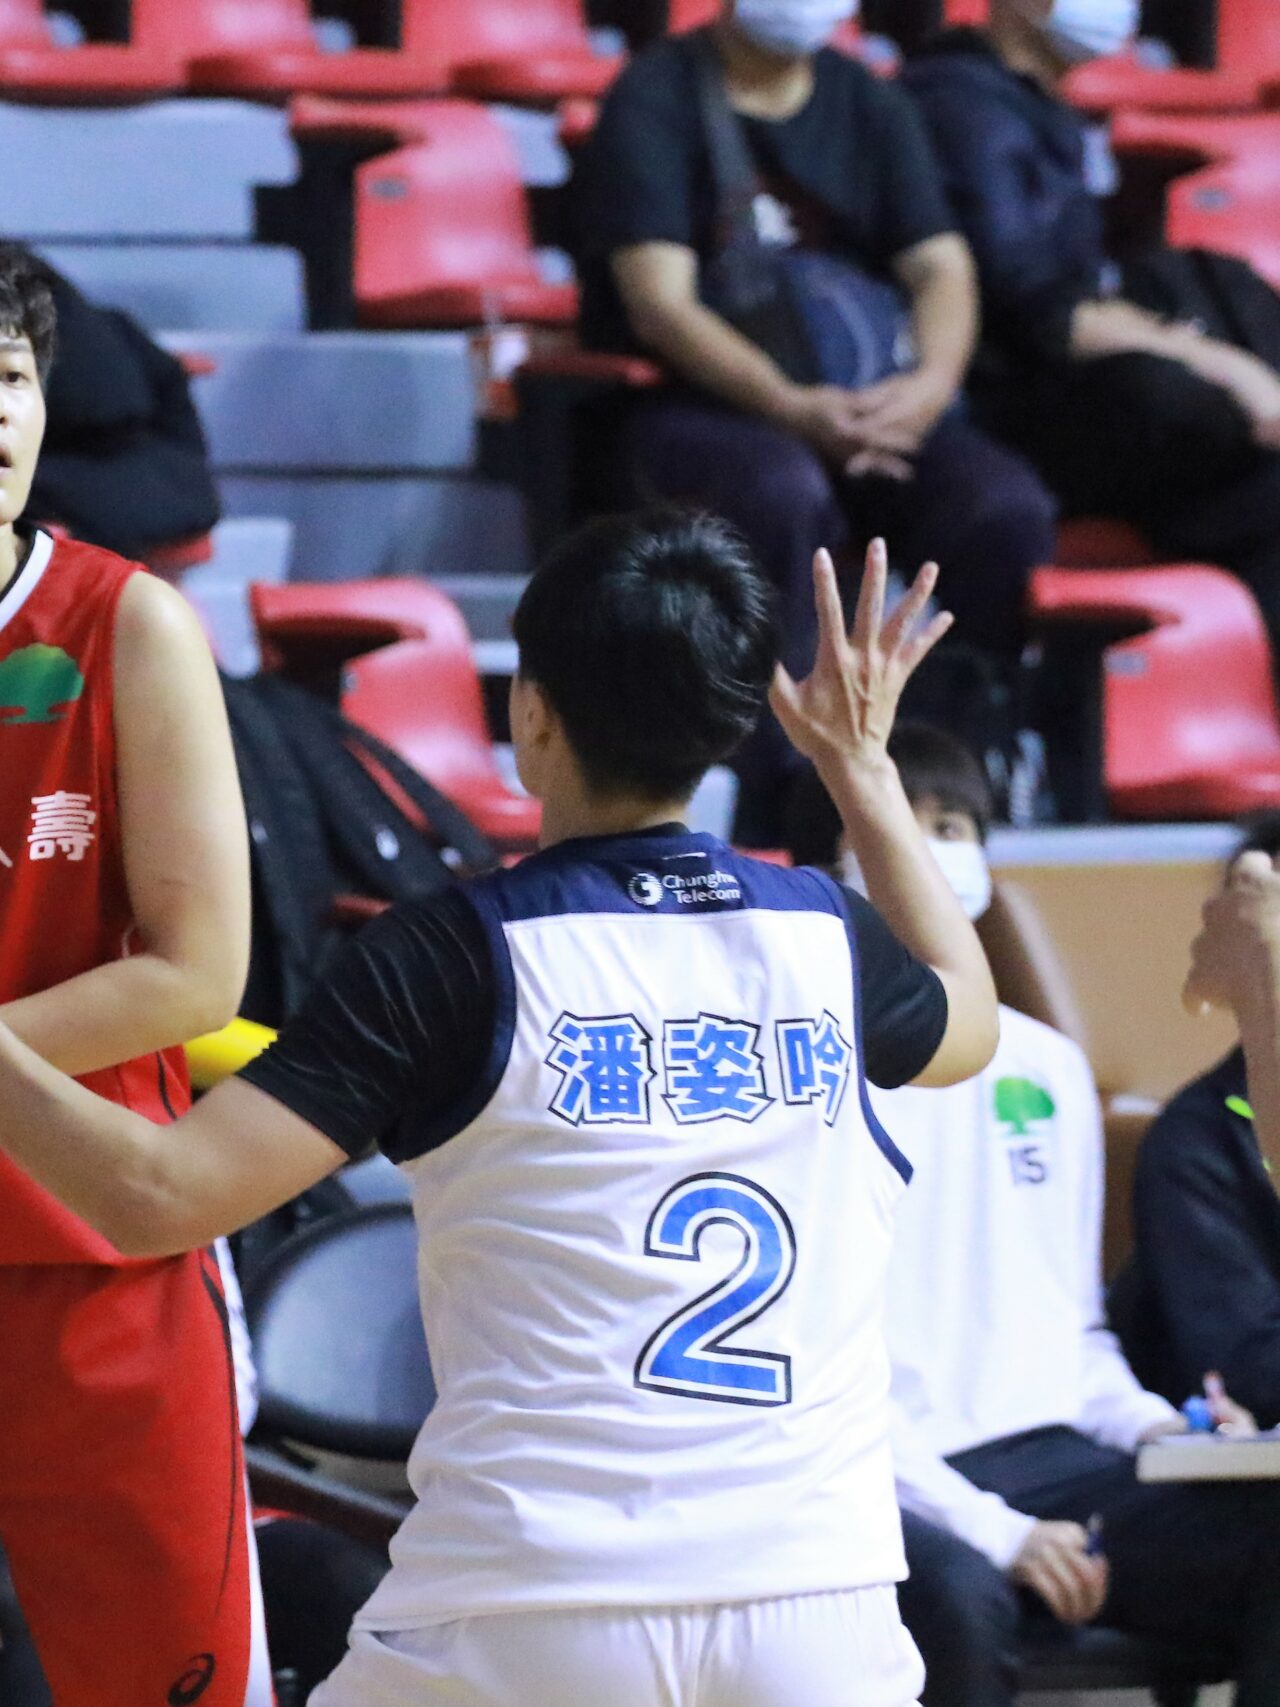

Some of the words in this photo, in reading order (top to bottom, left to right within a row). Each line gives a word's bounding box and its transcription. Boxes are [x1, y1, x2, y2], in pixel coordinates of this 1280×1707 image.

[672, 888, 742, 904] Telecom
[546, 1009, 852, 1127] 潘姿吟
[1008, 1145, 1047, 1187] 15
[634, 1171, 797, 1408] 2
